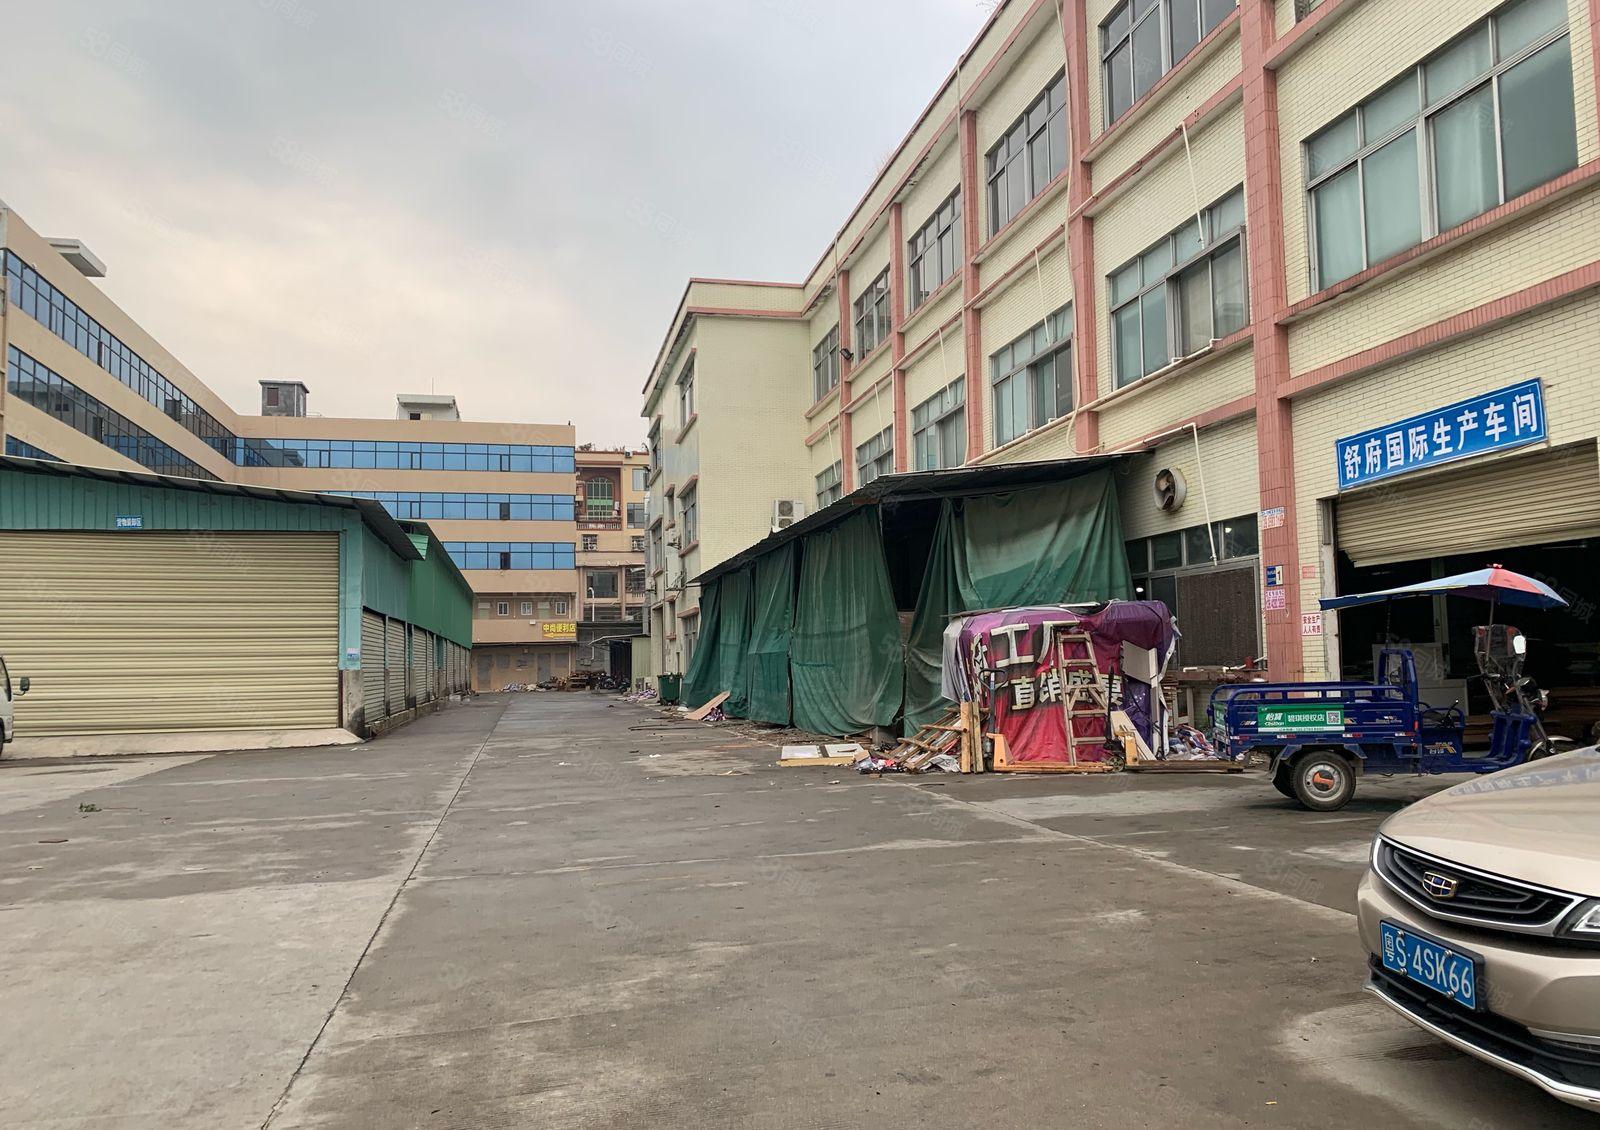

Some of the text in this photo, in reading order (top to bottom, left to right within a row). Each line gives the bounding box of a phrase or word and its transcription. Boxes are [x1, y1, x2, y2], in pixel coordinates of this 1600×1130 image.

[1344, 392, 1537, 480] 舒府国际生产车间
[1303, 615, 1320, 624] 安全生产
[1303, 625, 1320, 633] 人人有责
